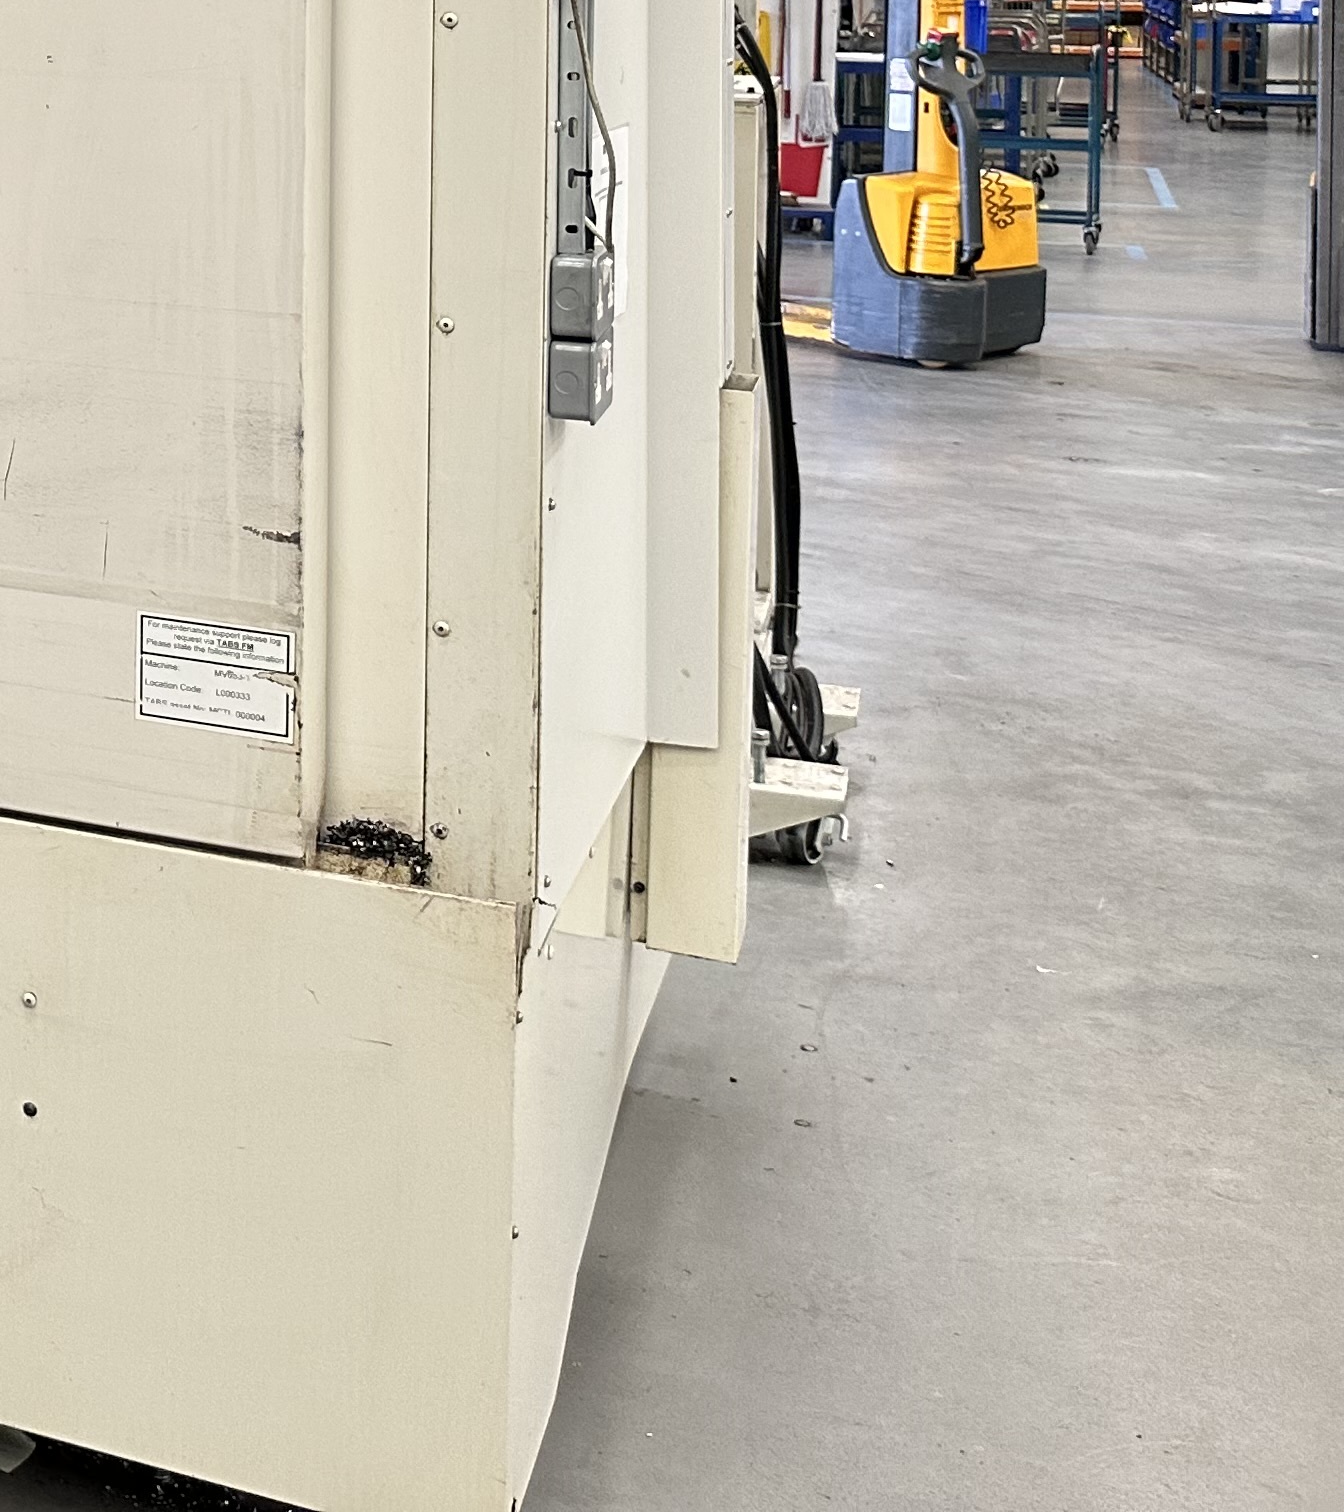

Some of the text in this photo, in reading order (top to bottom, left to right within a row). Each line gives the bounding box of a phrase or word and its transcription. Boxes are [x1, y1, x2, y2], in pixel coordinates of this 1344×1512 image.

[148, 619, 282, 647] For maintenance support please log
[173, 633, 202, 644] request
[203, 637, 215, 645] via
[146, 638, 285, 664] Please state the following information
[144, 678, 179, 691] Location
